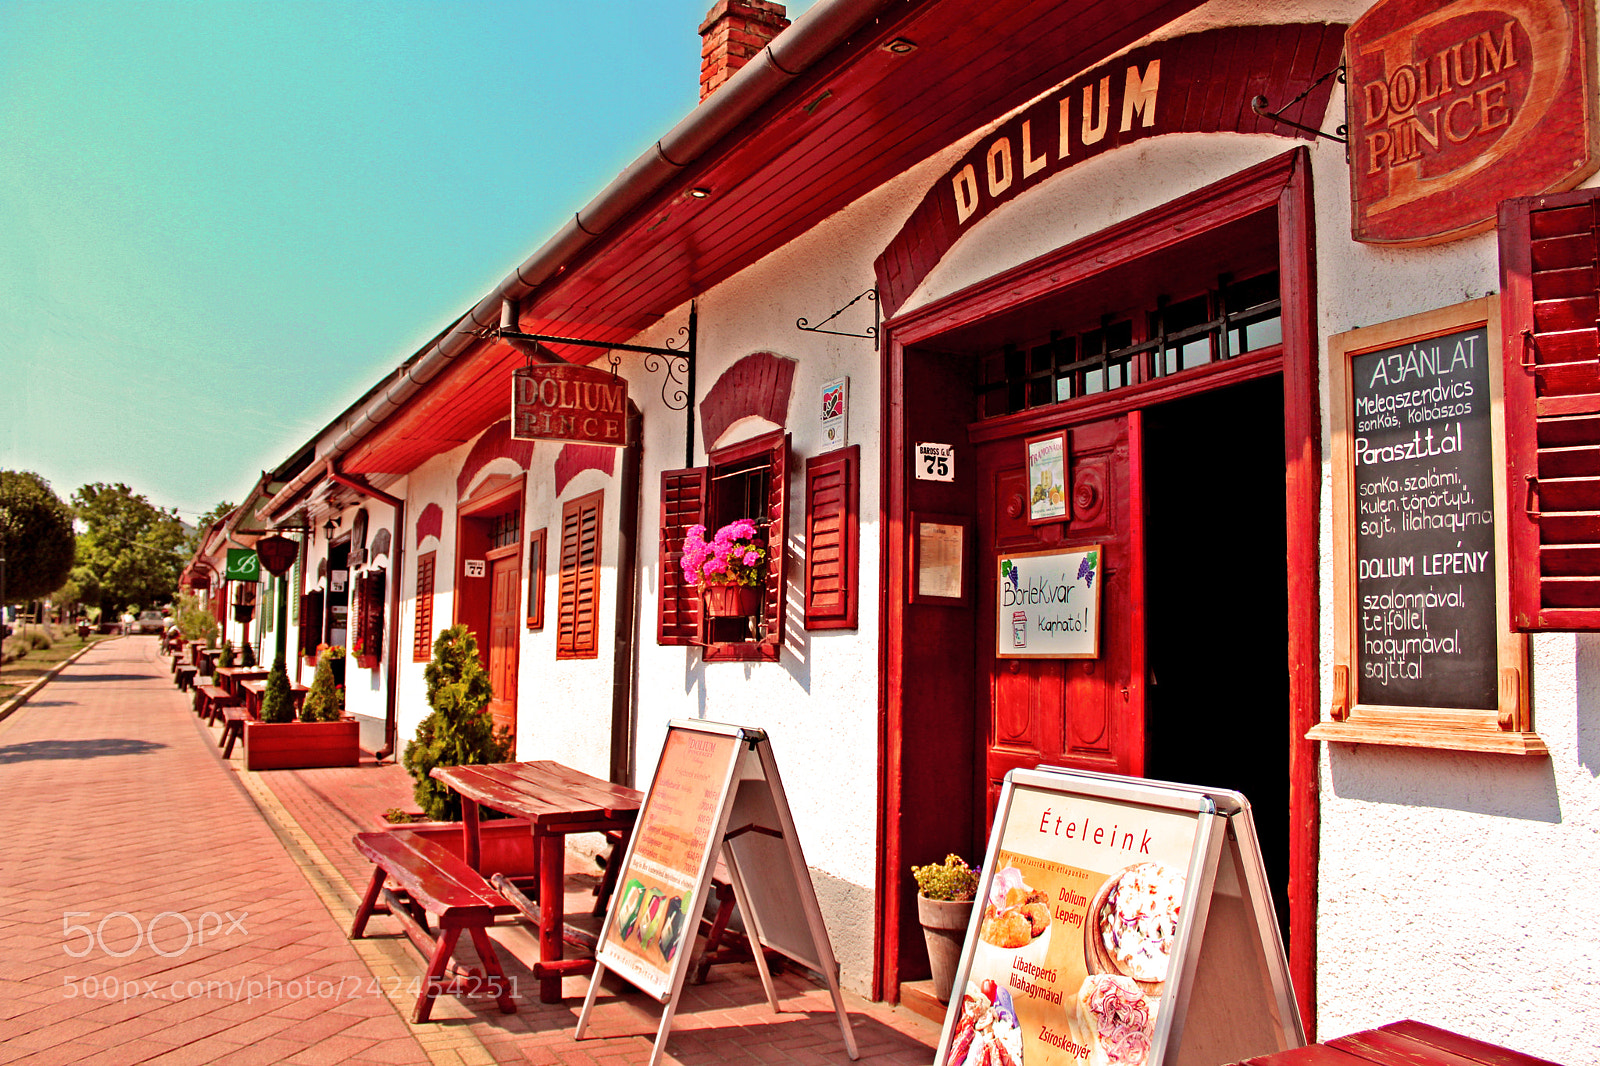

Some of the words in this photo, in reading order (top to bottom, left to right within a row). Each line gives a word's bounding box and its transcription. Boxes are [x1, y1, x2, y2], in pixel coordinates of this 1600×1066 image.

[1363, 20, 1519, 127] DOLIUM
[952, 59, 1161, 225] DOLIUM
[1365, 80, 1512, 176] PINCE
[1369, 335, 1479, 388] AJÁNLAT
[517, 376, 623, 414] DOLIUM
[1356, 378, 1474, 417] Melegszendvics
[521, 411, 620, 438] PINCE
[920, 447, 939, 455] BAROSS
[1355, 422, 1462, 466] Paraszttál
[924, 455, 949, 476] 75
[1402, 509, 1493, 533] lilahagyma
[470, 566, 483, 575] 77
[1359, 555, 1414, 580] DOLIUM
[1423, 540, 1489, 576] LEPÉNY
[1363, 584, 1465, 610] szalonnával,
[1364, 628, 1461, 660] hagymával,
[1365, 654, 1422, 686] sajttal
[1039, 808, 1152, 854] Ételeink
[1058, 887, 1087, 907] Dolium
[1055, 905, 1084, 929] Lepény
[1009, 972, 1063, 1006] lilahagymával
[1038, 1025, 1091, 1060] Zsíroskenyér
